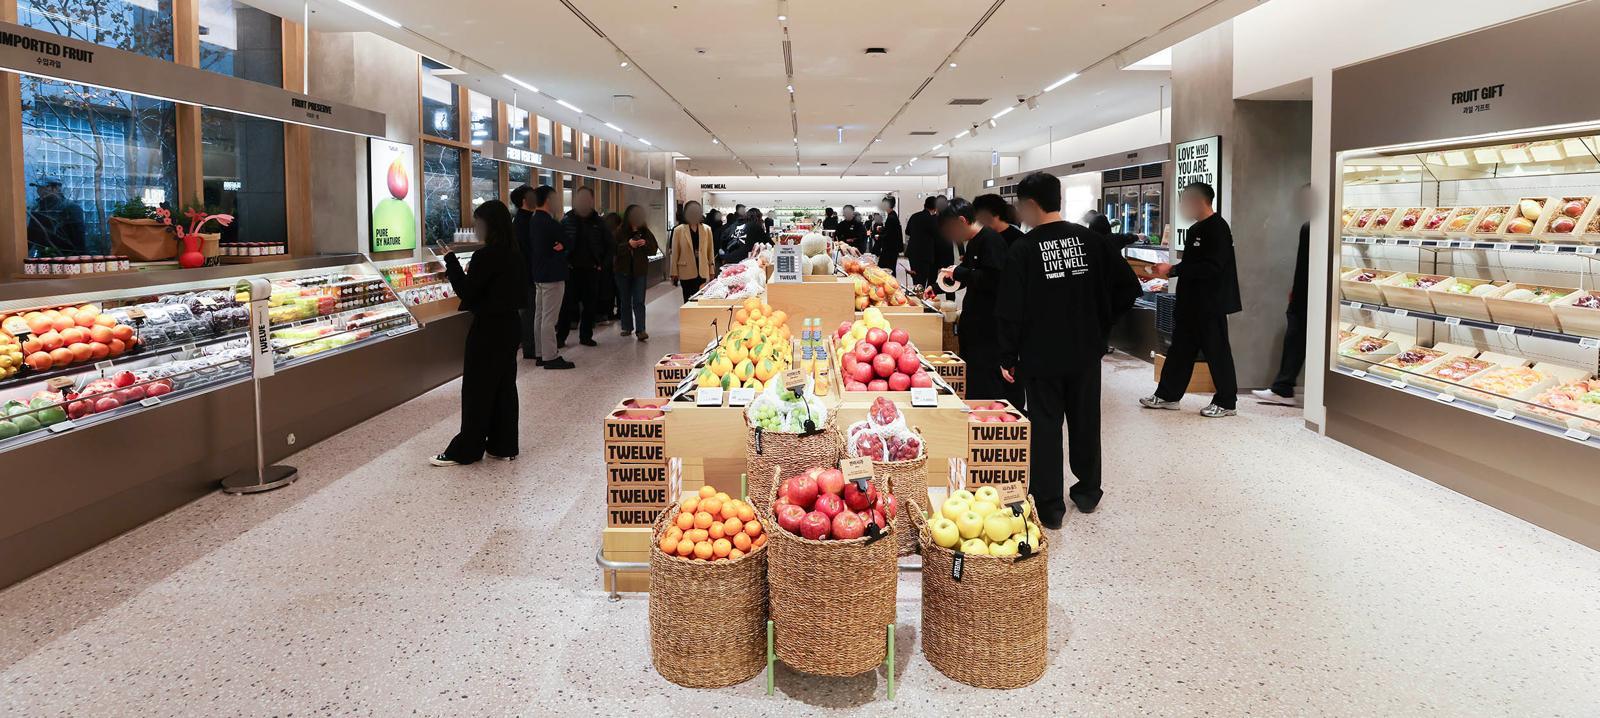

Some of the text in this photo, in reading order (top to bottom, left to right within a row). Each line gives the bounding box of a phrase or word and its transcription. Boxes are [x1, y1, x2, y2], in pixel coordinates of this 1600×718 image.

[0, 32, 94, 63] IMPORTED FRUIT
[1451, 84, 1504, 104] FRUIT GIFT
[1178, 144, 1209, 161] LOVE WHO
[1178, 159, 1209, 175] YOU ARE.
[1178, 176, 1186, 189] BE
[1205, 173, 1213, 184] TO
[376, 228, 388, 237] PURE
[376, 236, 401, 246] BY NATURE
[1039, 236, 1085, 251] LOVE WELL.
[1041, 246, 1087, 261] GIVE WELL.
[1043, 260, 1064, 272] LIVE
[1064, 256, 1089, 269] WELL.
[1045, 271, 1065, 279] TWELVE
[258, 324, 269, 355] TWELVE
[607, 423, 663, 438] TWELVE
[971, 426, 1028, 441] TWELVE
[607, 445, 663, 460] TWELVE
[971, 448, 1027, 463] TWELVE
[609, 467, 666, 482] TWELVE
[969, 469, 1026, 484] TWELVE
[610, 489, 666, 503] TWELVE
[610, 510, 662, 525] TWELV
